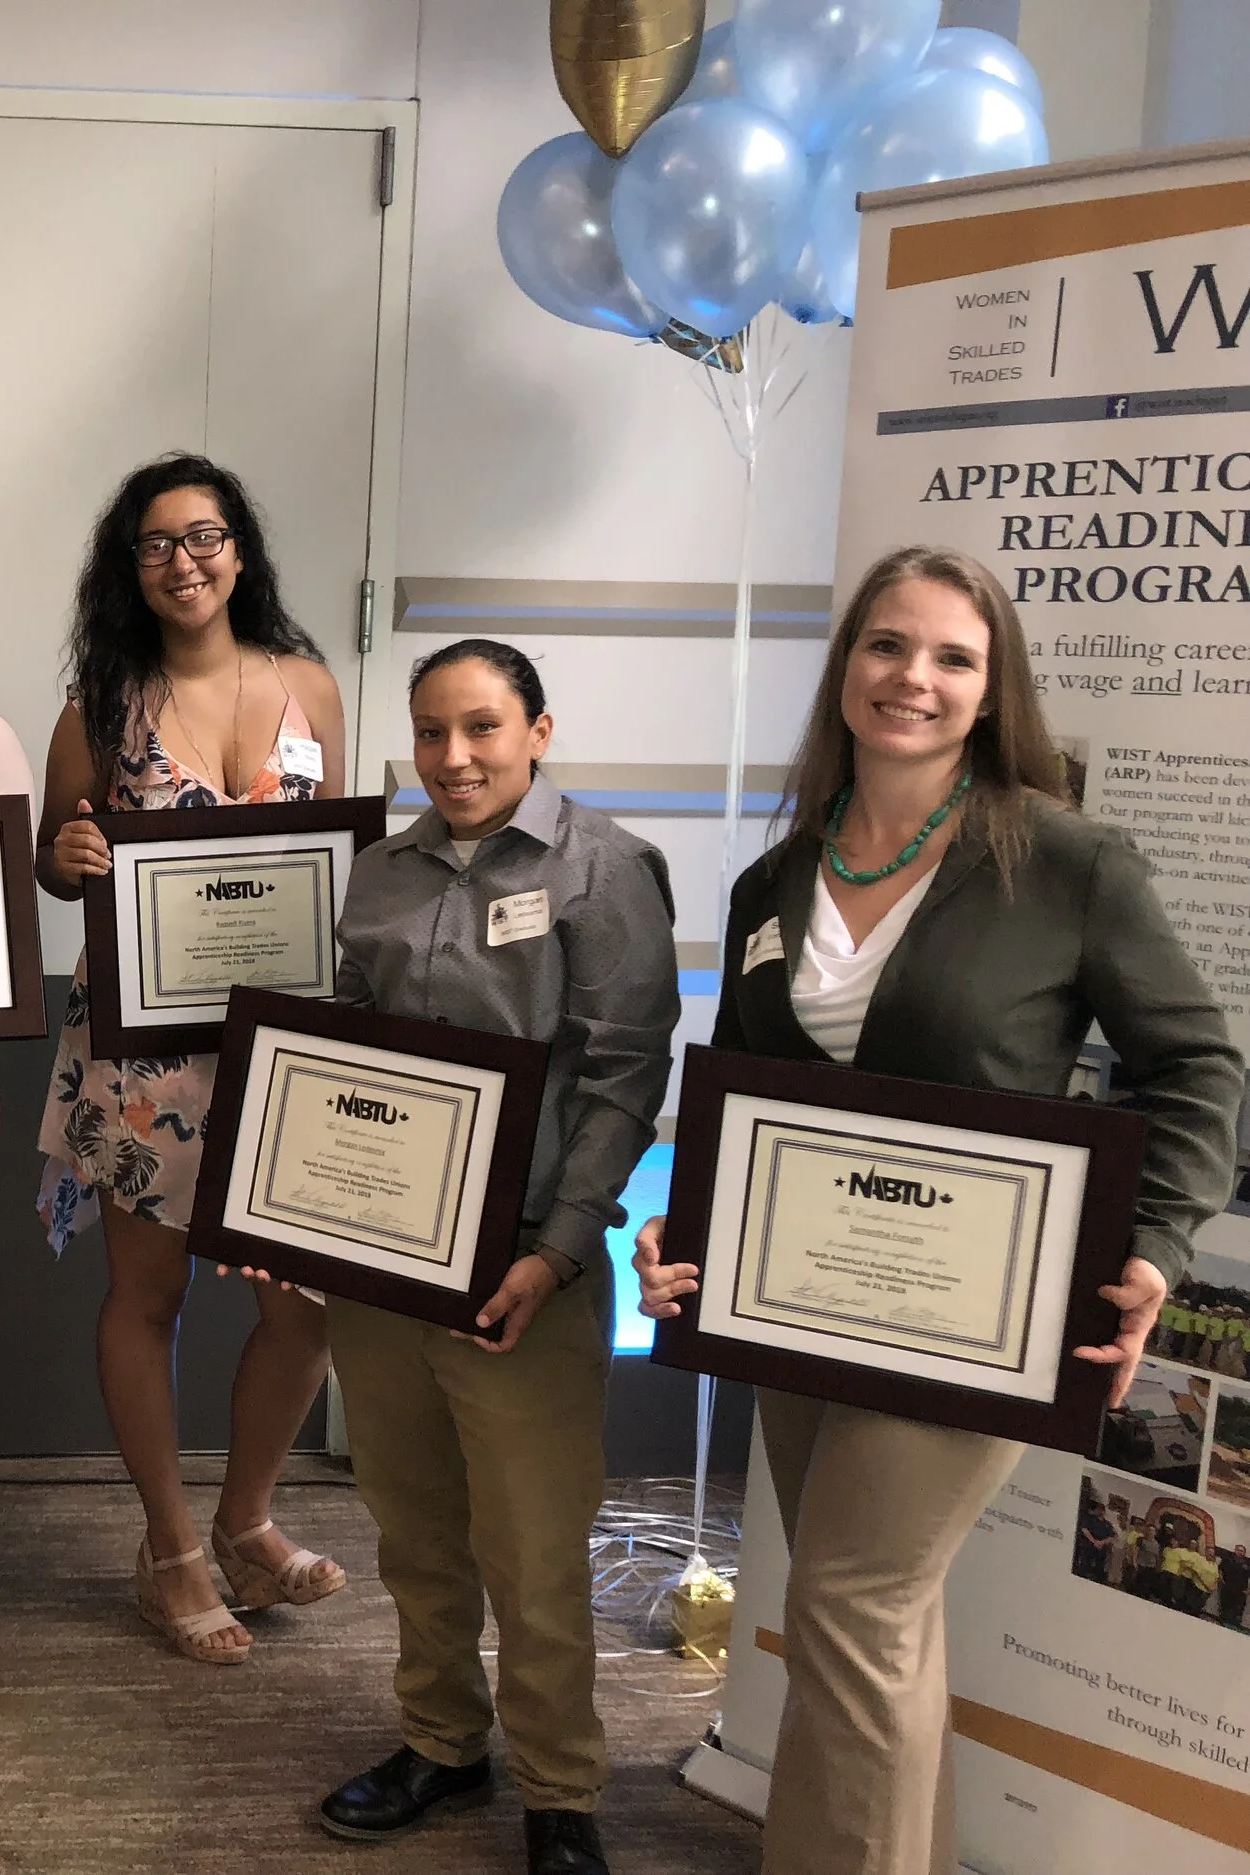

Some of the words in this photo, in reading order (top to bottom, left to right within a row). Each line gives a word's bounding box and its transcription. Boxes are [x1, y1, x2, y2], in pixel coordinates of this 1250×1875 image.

[919, 452, 1250, 502] APPRENTIC
[1012, 564, 1250, 603] PROGRA
[1053, 634, 1166, 667] fulfilling
[1058, 674, 1124, 698] wage
[1131, 669, 1183, 695] and
[1106, 747, 1151, 761] WIST
[1154, 751, 1250, 768] Apprentices
[1104, 767, 1151, 783] (ARP)
[1156, 771, 1179, 782] has
[1184, 771, 1218, 785] been
[1222, 773, 1250, 787] dev
[1102, 788, 1153, 800] women
[1157, 791, 1213, 805] succeed
[1218, 795, 1231, 806] in
[1100, 803, 1128, 816] Our
[1133, 808, 1193, 824] program
[1198, 811, 1223, 824] will
[1122, 826, 1200, 845] ntroducing
[1204, 834, 1230, 846] you
[1209, 850, 1250, 869] throu
[1165, 898, 1182, 911] of
[1186, 900, 1209, 914] the
[1196, 923, 1223, 934] one
[1228, 924, 1245, 937] of
[1195, 943, 1213, 953] an
[1003, 1633, 1100, 1689] Promoting
[1106, 1672, 1162, 1707] better
[1166, 1696, 1209, 1725] lives
[1216, 1715, 1245, 1739] for
[1107, 1706, 1182, 1748] through
[1188, 1739, 1249, 1774] skilled
